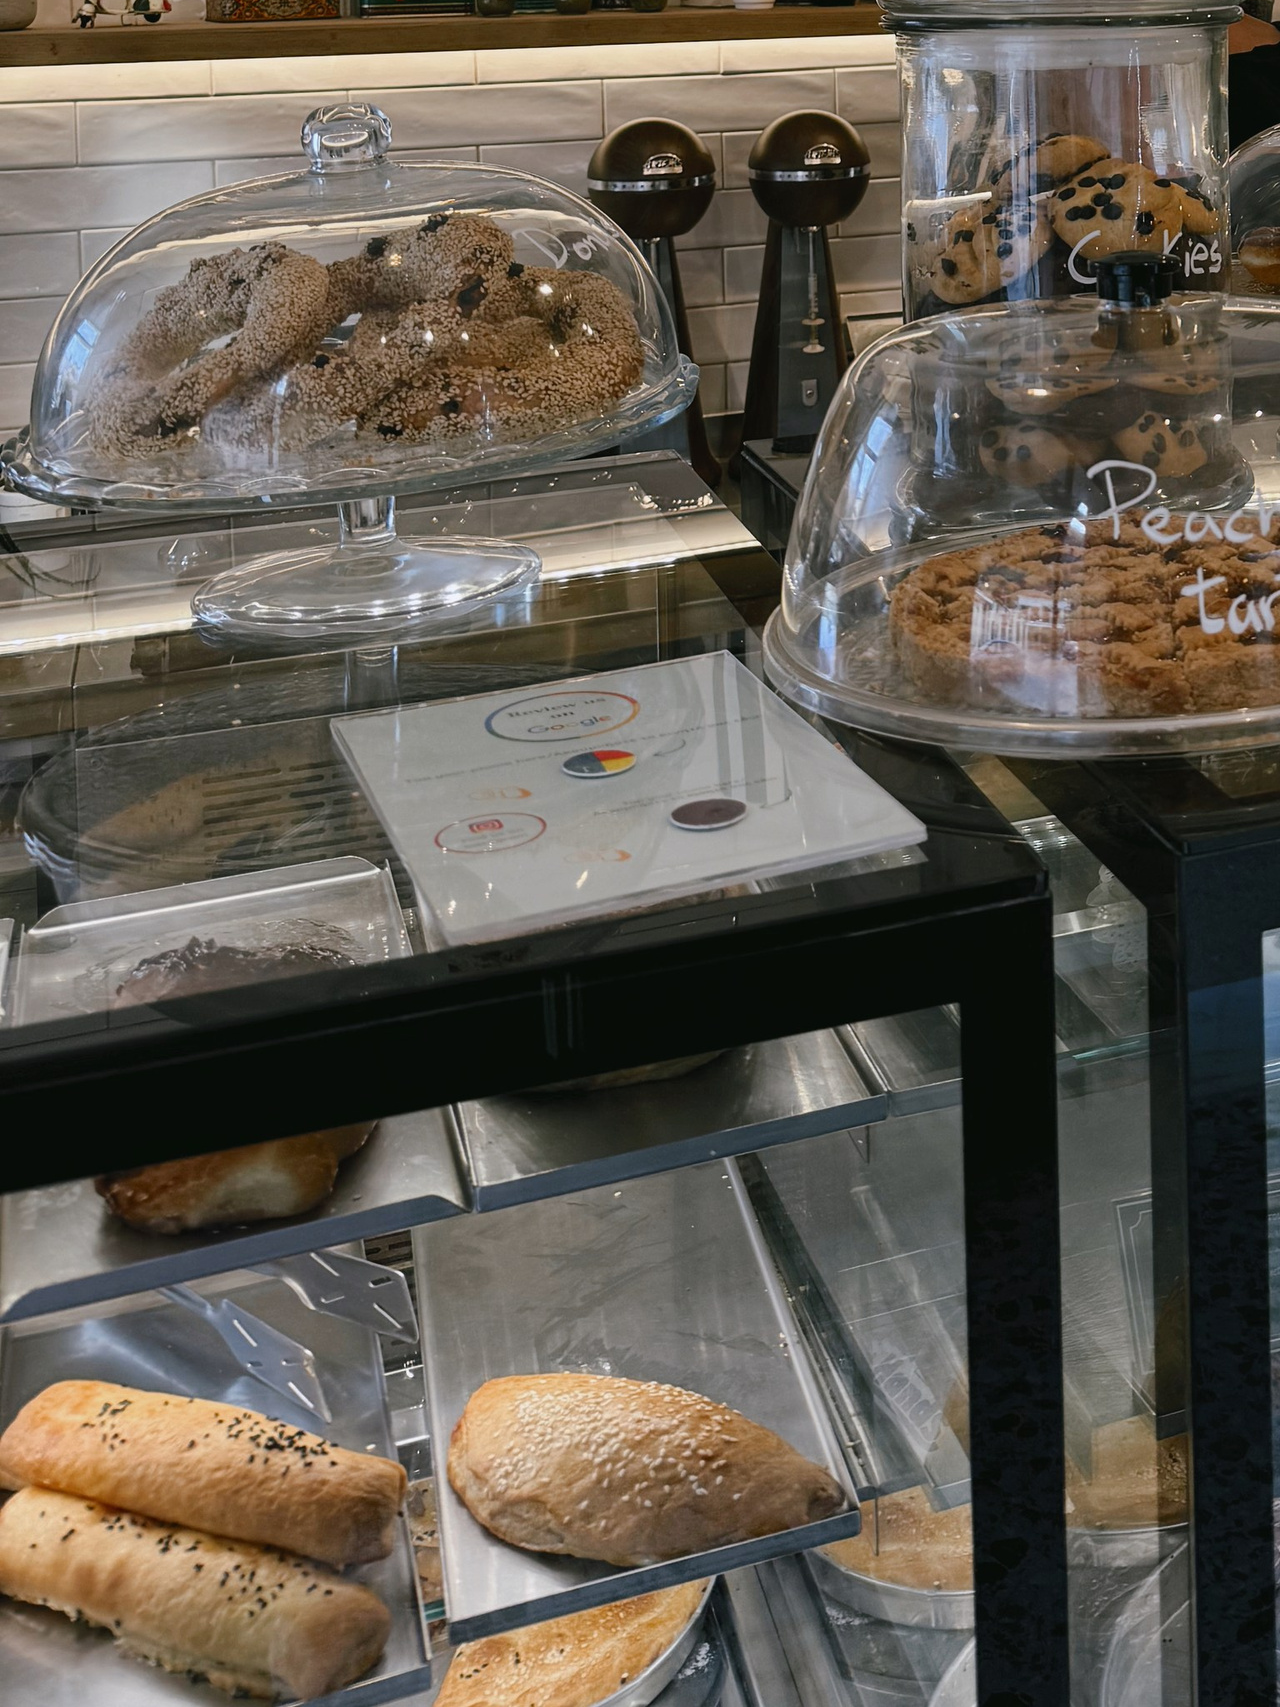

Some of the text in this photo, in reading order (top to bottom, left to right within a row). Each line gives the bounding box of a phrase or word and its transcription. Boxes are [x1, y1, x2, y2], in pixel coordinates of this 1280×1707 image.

[1067, 230, 1222, 285] Ckies
[508, 703, 576, 717] Review
[527, 716, 611, 734] Google
